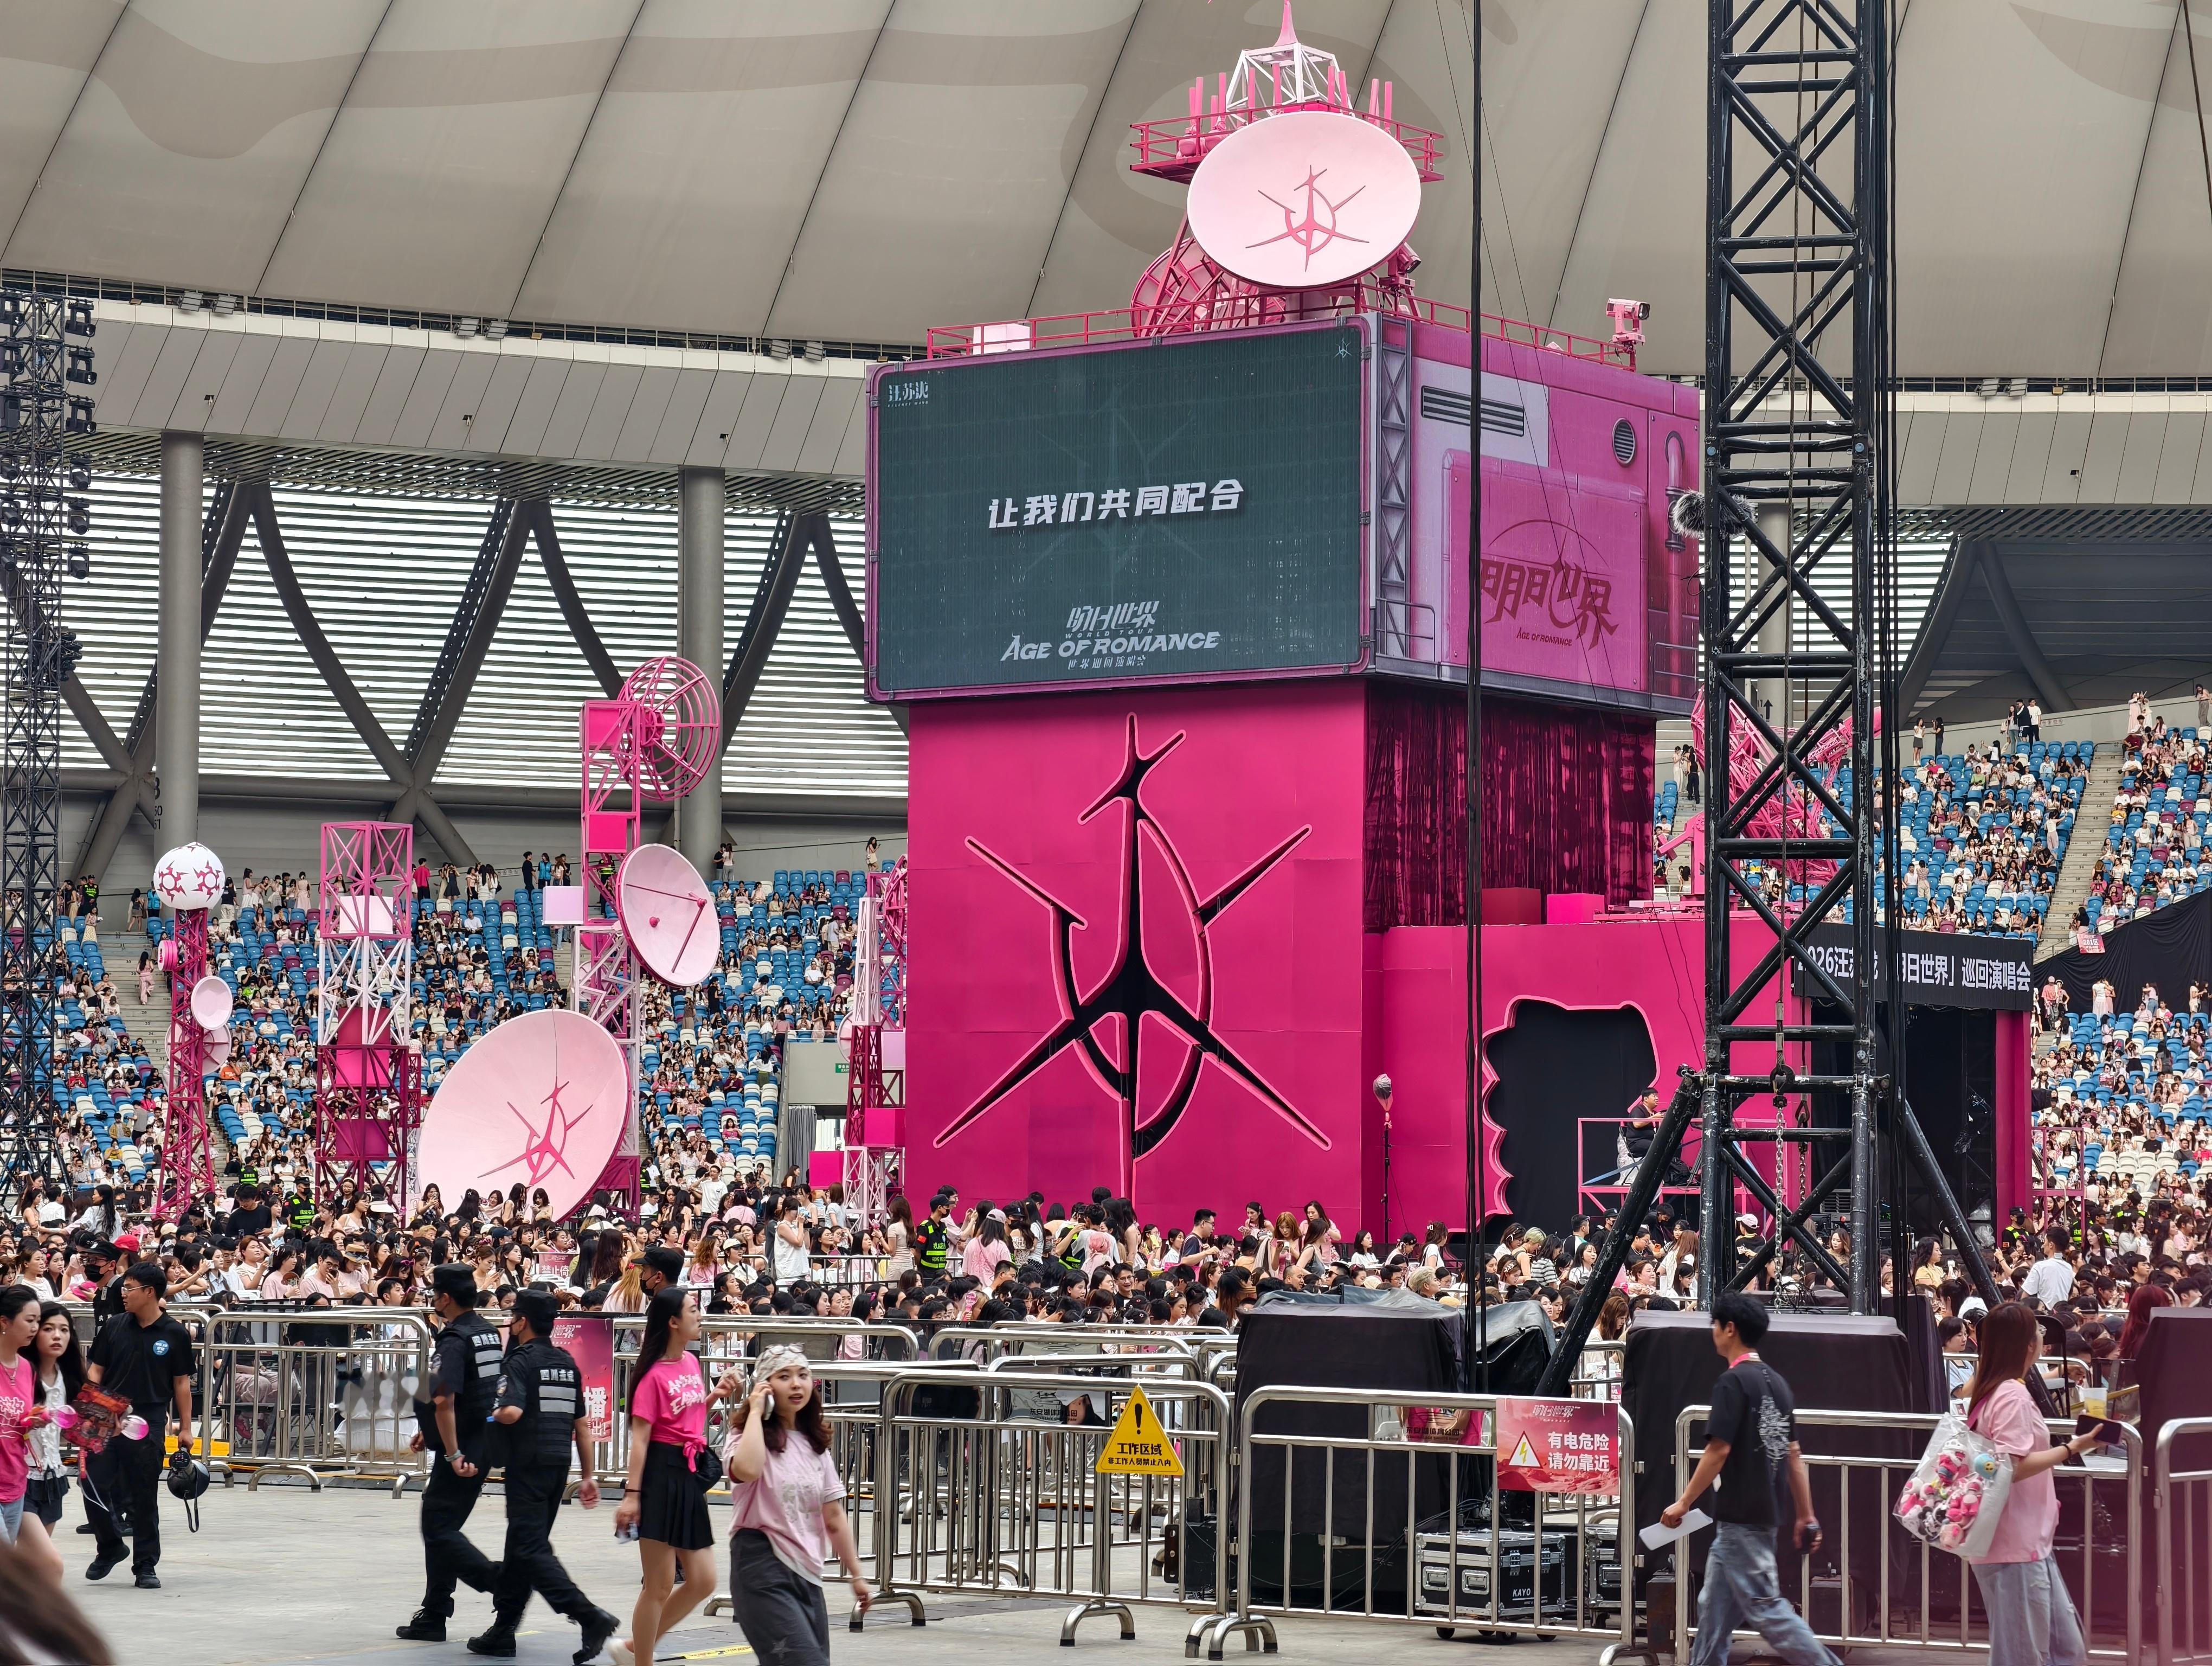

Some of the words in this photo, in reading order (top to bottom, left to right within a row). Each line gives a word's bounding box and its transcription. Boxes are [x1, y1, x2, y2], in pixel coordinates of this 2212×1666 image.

[988, 479, 1244, 528] 让我们共同配合
[1065, 631, 1110, 639] WORLD
[1119, 627, 1154, 636] TOUR
[1516, 627, 1530, 640] AGE
[1540, 635, 1572, 646] ROMANCE
[1000, 634, 1053, 662] AGE
[1058, 641, 1093, 658] OF
[1091, 631, 1221, 655] ROMANCE
[1962, 957, 2031, 992] 巡回演唱会
[583, 1386, 607, 1419] 播
[1117, 1443, 1162, 1456] 工作区域
[1548, 1431, 1610, 1451] 有电危险
[1108, 1457, 1171, 1466] 非工作人员禁止入内
[1548, 1452, 1610, 1472] 请勿靠近
[1512, 1588, 1531, 1597] KAYO
